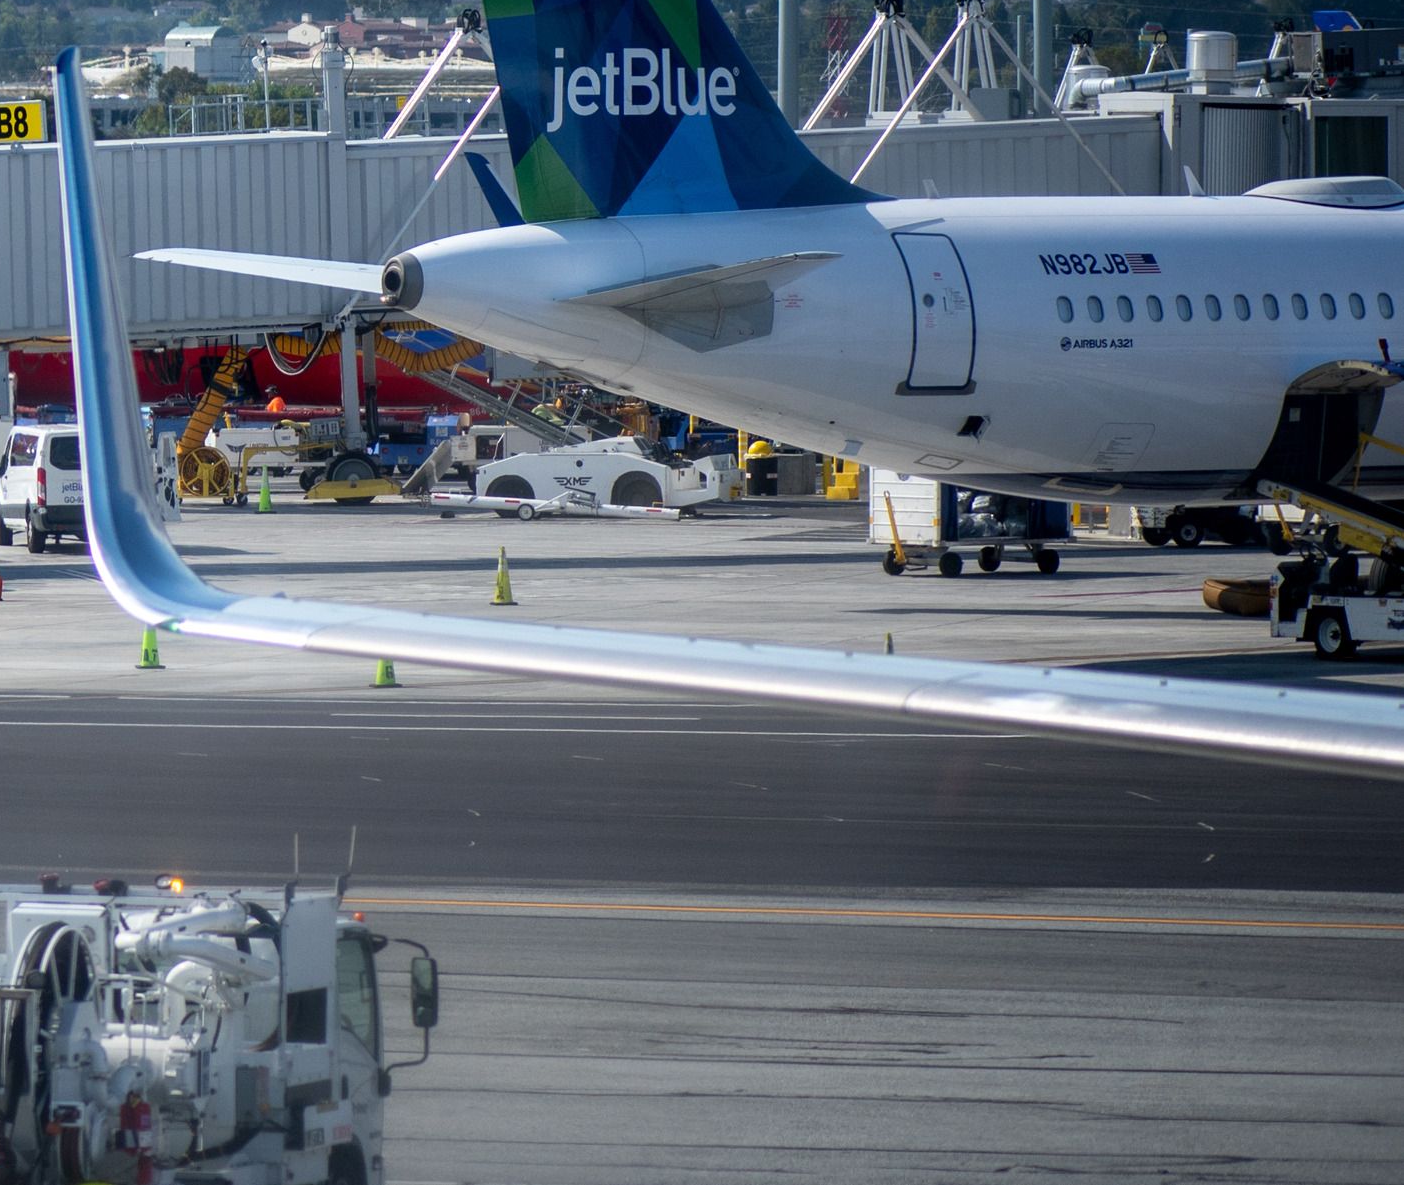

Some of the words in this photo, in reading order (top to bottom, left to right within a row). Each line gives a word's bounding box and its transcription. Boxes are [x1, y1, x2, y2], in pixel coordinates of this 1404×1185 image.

[1039, 253, 1129, 275] N982JB
[1073, 339, 1108, 348] AIRBUS
[1109, 338, 1133, 349] A321
